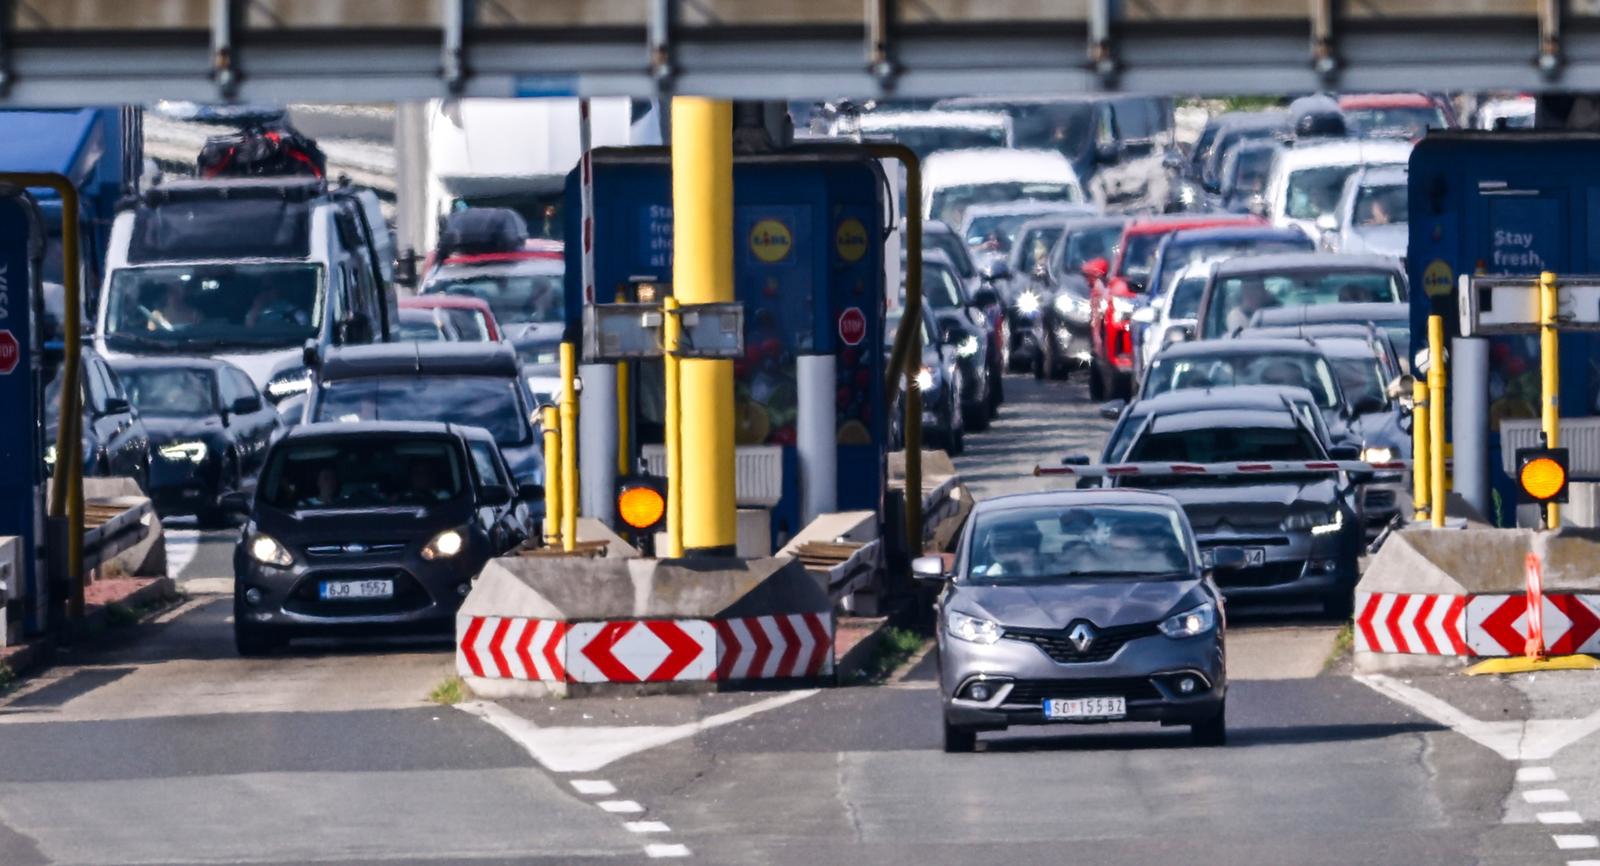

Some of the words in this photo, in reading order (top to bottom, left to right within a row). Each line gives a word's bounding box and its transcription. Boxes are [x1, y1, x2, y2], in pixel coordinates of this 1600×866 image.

[1494, 230, 1533, 248] Stay
[1493, 249, 1545, 269] fresh,
[842, 320, 863, 333] STOP
[360, 581, 387, 594] 1552
[1054, 702, 1069, 714] SO
